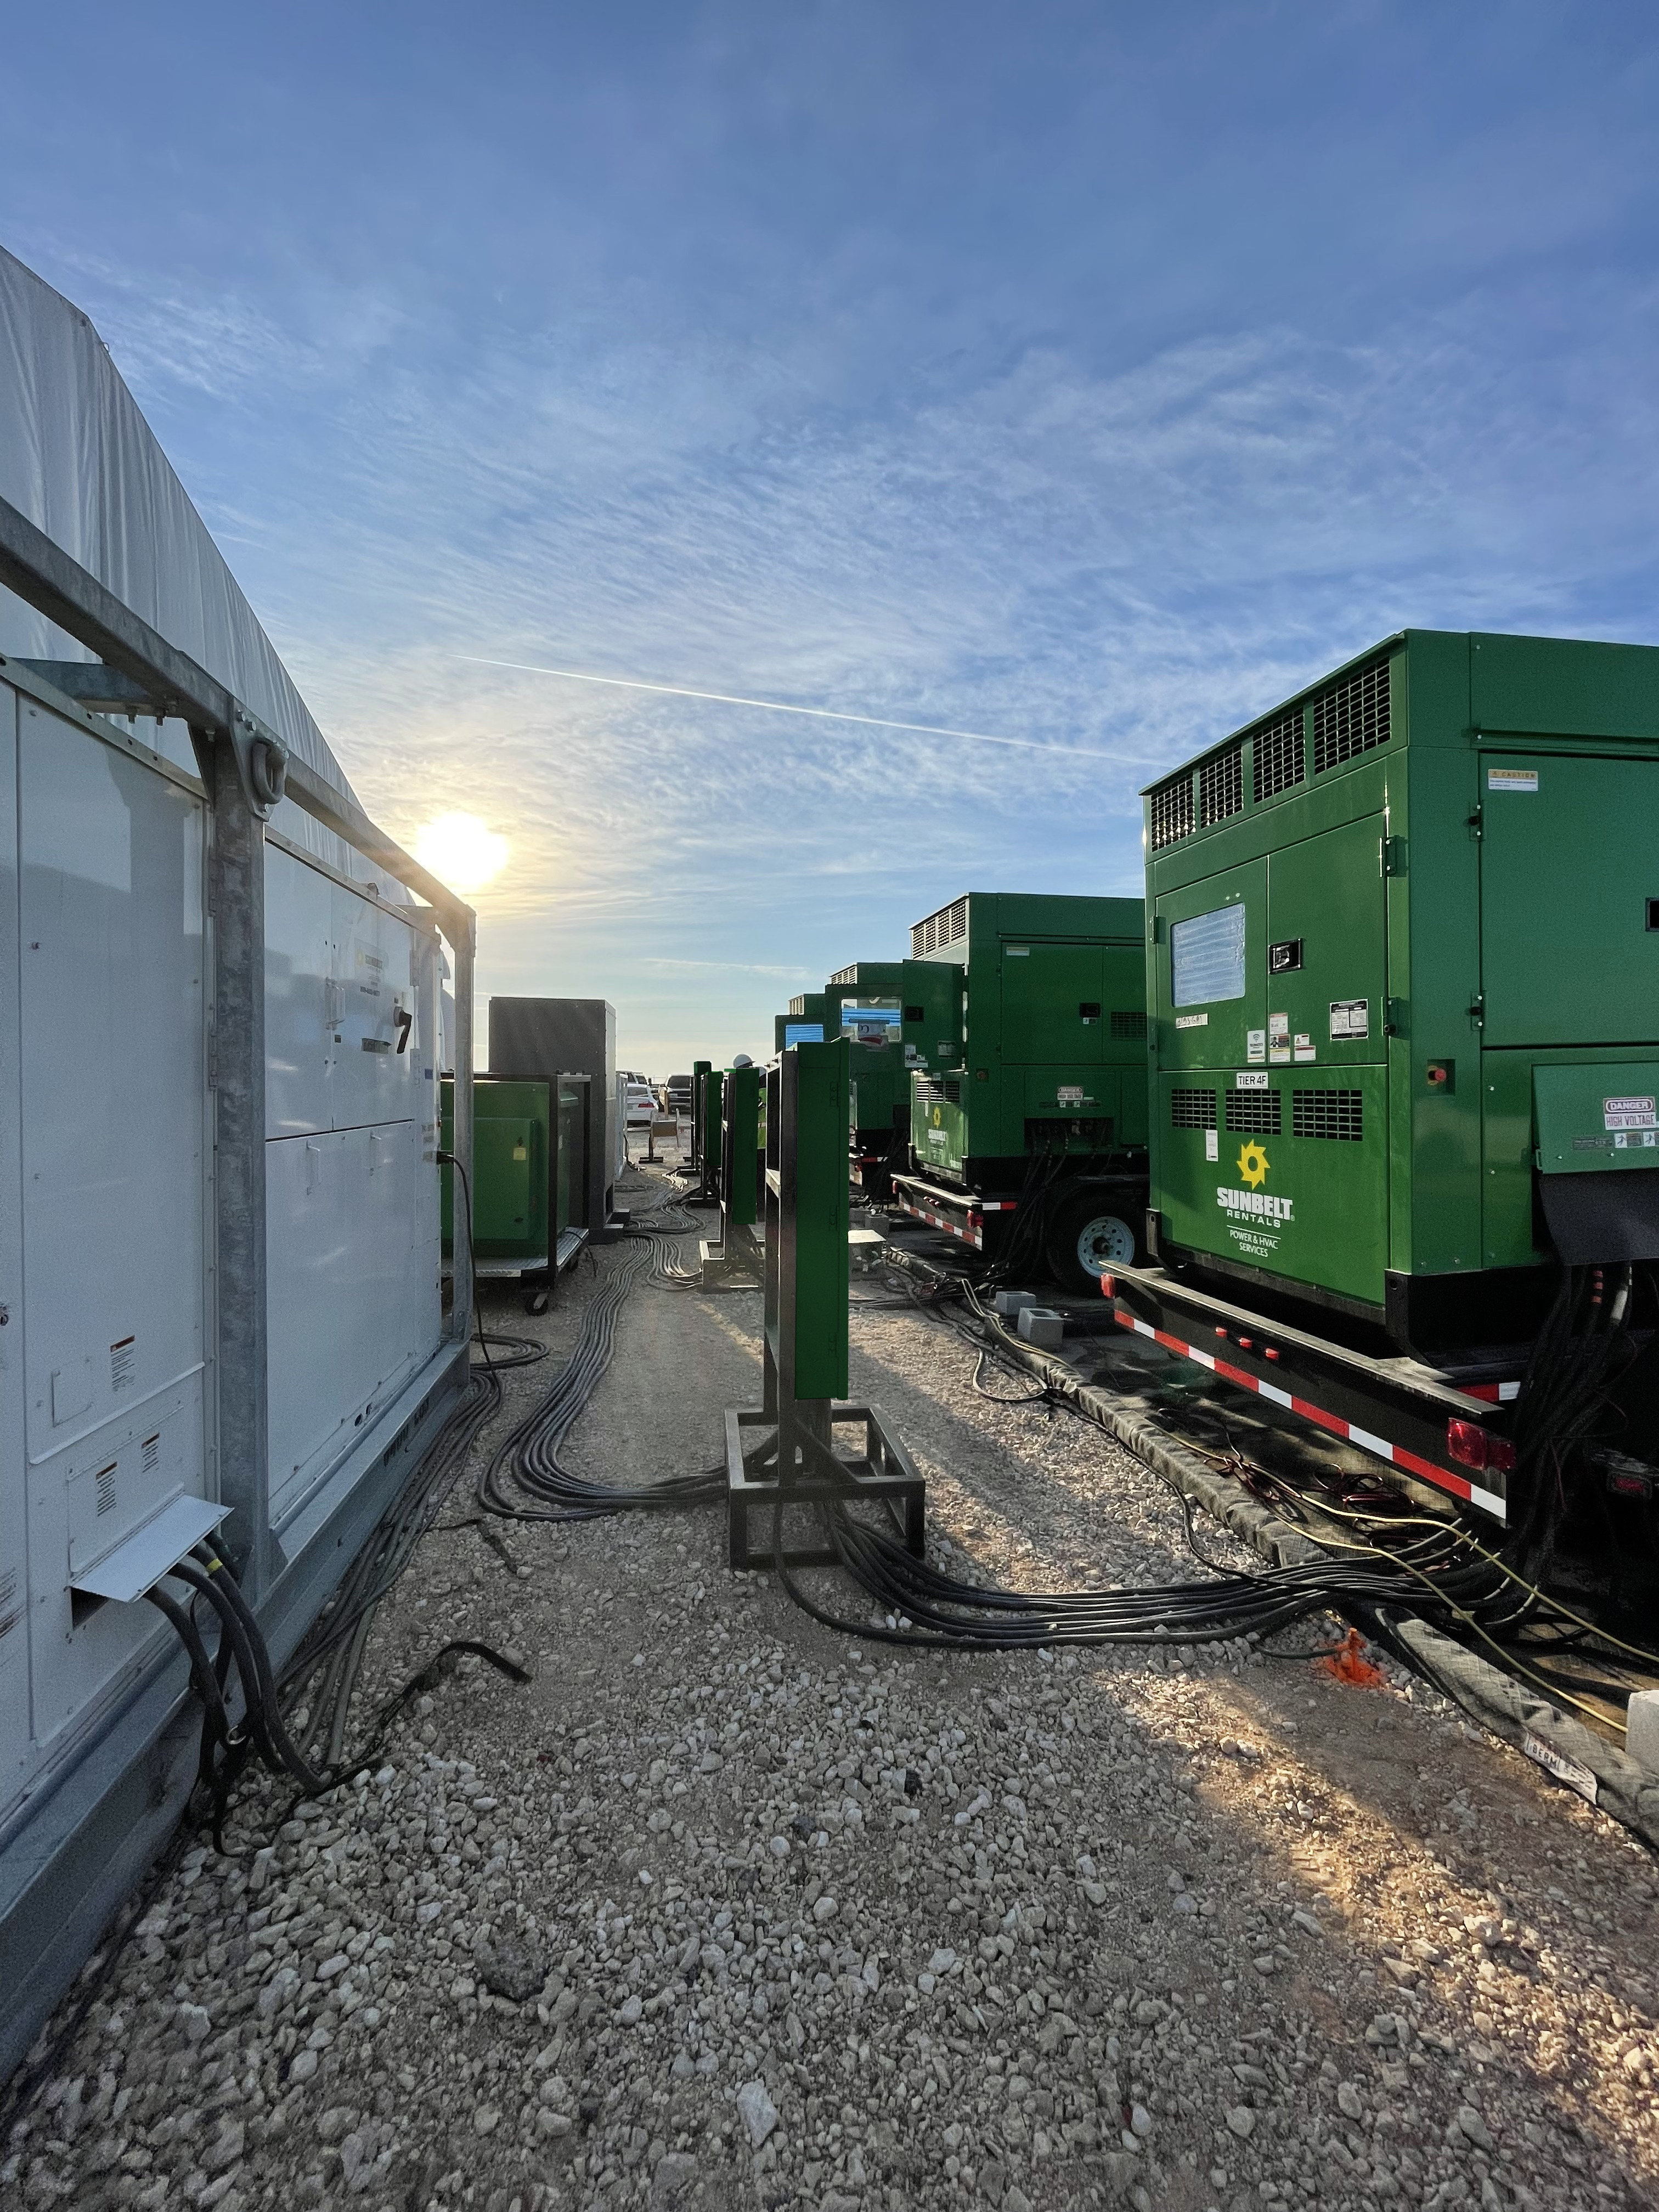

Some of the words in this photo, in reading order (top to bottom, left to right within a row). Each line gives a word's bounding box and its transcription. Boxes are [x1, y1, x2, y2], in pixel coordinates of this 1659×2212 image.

[1238, 1076, 1255, 1085] TIER
[1257, 1075, 1266, 1085] 4F
[1610, 1101, 1649, 1110] DANGER
[1606, 1116, 1622, 1126] HIGH
[1624, 1114, 1655, 1125] VOLTAGE
[1217, 1187, 1293, 1220] SUNBELT
[1227, 1209, 1281, 1228] RENTALS
[1229, 1229, 1252, 1243] POWER
[1252, 1234, 1259, 1244] &
[1259, 1237, 1278, 1250] HVAC
[1239, 1242, 1268, 1257] SERVICES
